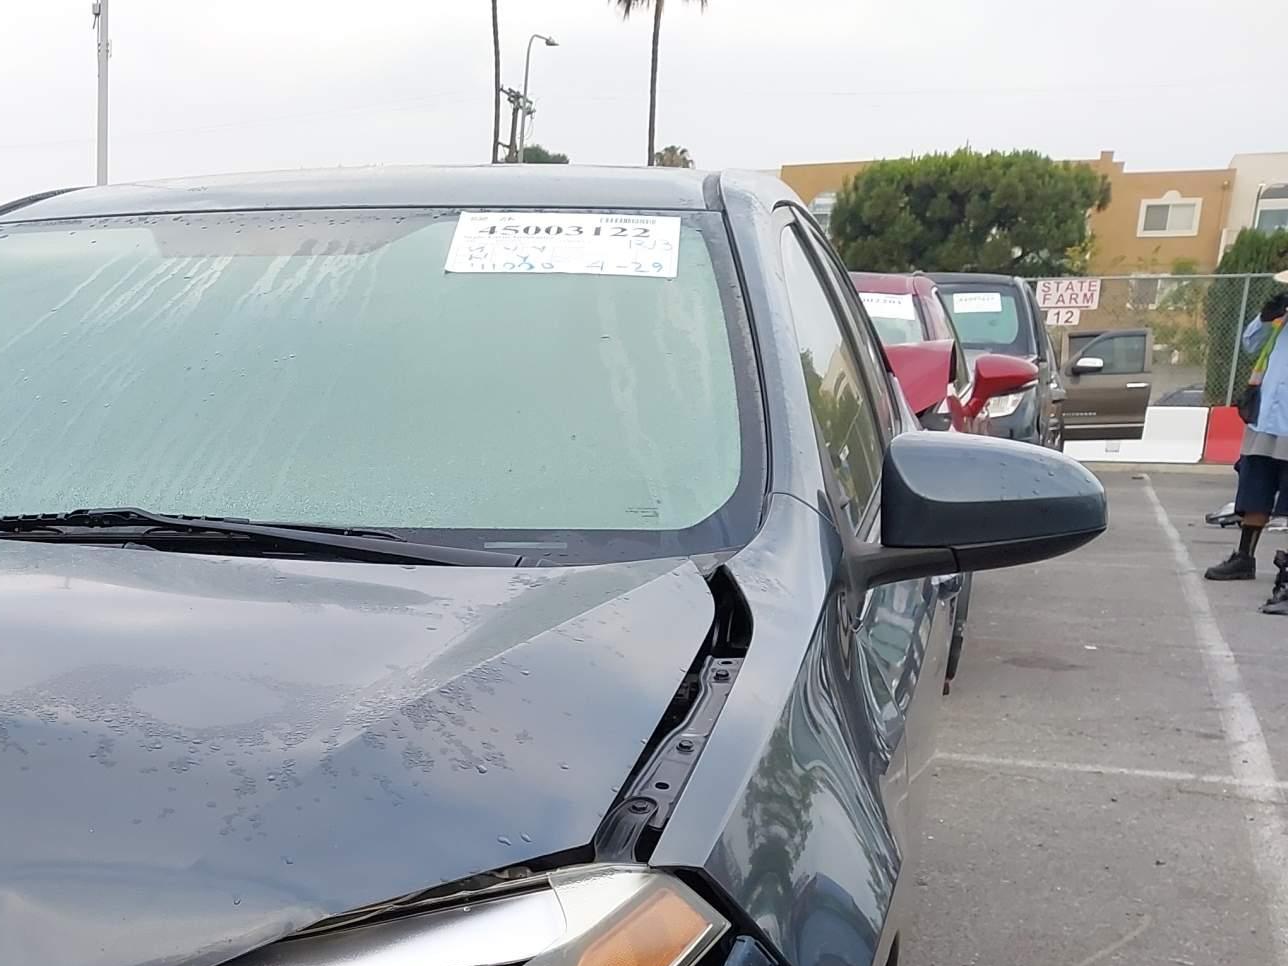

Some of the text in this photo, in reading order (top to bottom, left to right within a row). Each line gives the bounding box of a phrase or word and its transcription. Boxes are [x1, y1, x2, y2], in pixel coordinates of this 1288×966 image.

[477, 225, 651, 238] 45003122
[1041, 280, 1097, 293] STATE
[1042, 292, 1094, 305] FARM
[1053, 309, 1074, 324] 12
